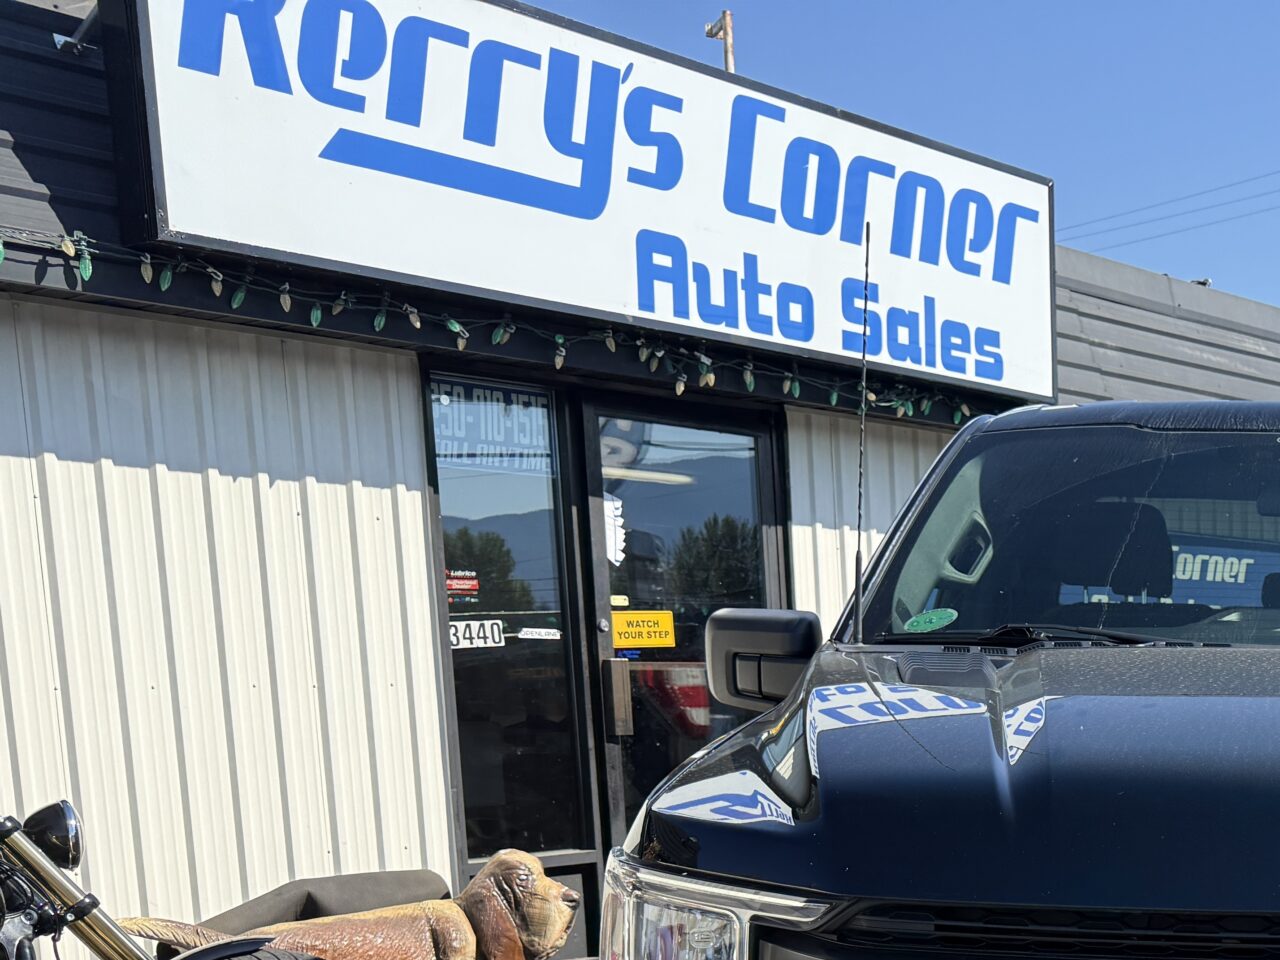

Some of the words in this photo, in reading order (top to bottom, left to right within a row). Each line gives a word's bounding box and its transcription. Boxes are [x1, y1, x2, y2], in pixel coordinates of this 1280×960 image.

[723, 94, 1039, 285] Corner
[636, 228, 815, 342] Auto
[841, 277, 1004, 382] Sales
[450, 623, 502, 647] 3440
[617, 631, 644, 640] YOUR
[646, 630, 670, 639] STEP
[626, 620, 660, 629] WATCH
